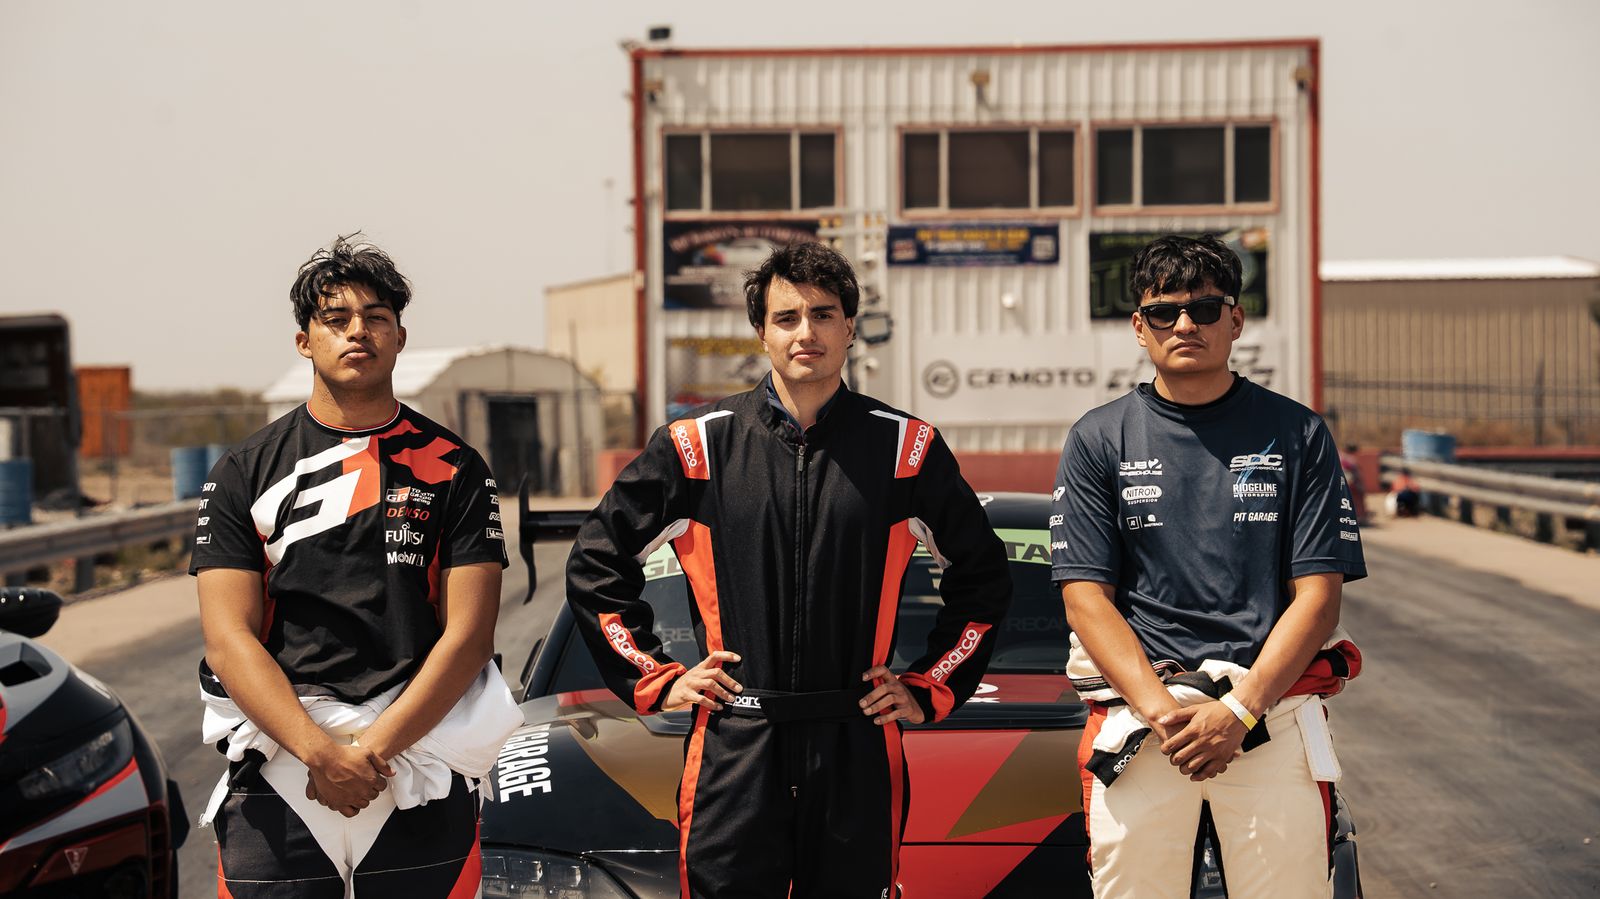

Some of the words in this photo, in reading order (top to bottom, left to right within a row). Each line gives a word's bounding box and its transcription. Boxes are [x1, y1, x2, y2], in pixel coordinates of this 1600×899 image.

[966, 368, 1096, 389] CFMOTO
[675, 425, 698, 469] sparco
[908, 424, 931, 468] sparco
[1229, 453, 1283, 468] SDC
[1126, 488, 1158, 499] NITRON
[1232, 483, 1278, 493] RIDGELINE
[385, 505, 430, 521] DENSO
[1233, 512, 1247, 522] PIT
[1248, 512, 1279, 522] GARAGE
[605, 622, 655, 675] sparco
[931, 628, 982, 683] sparco
